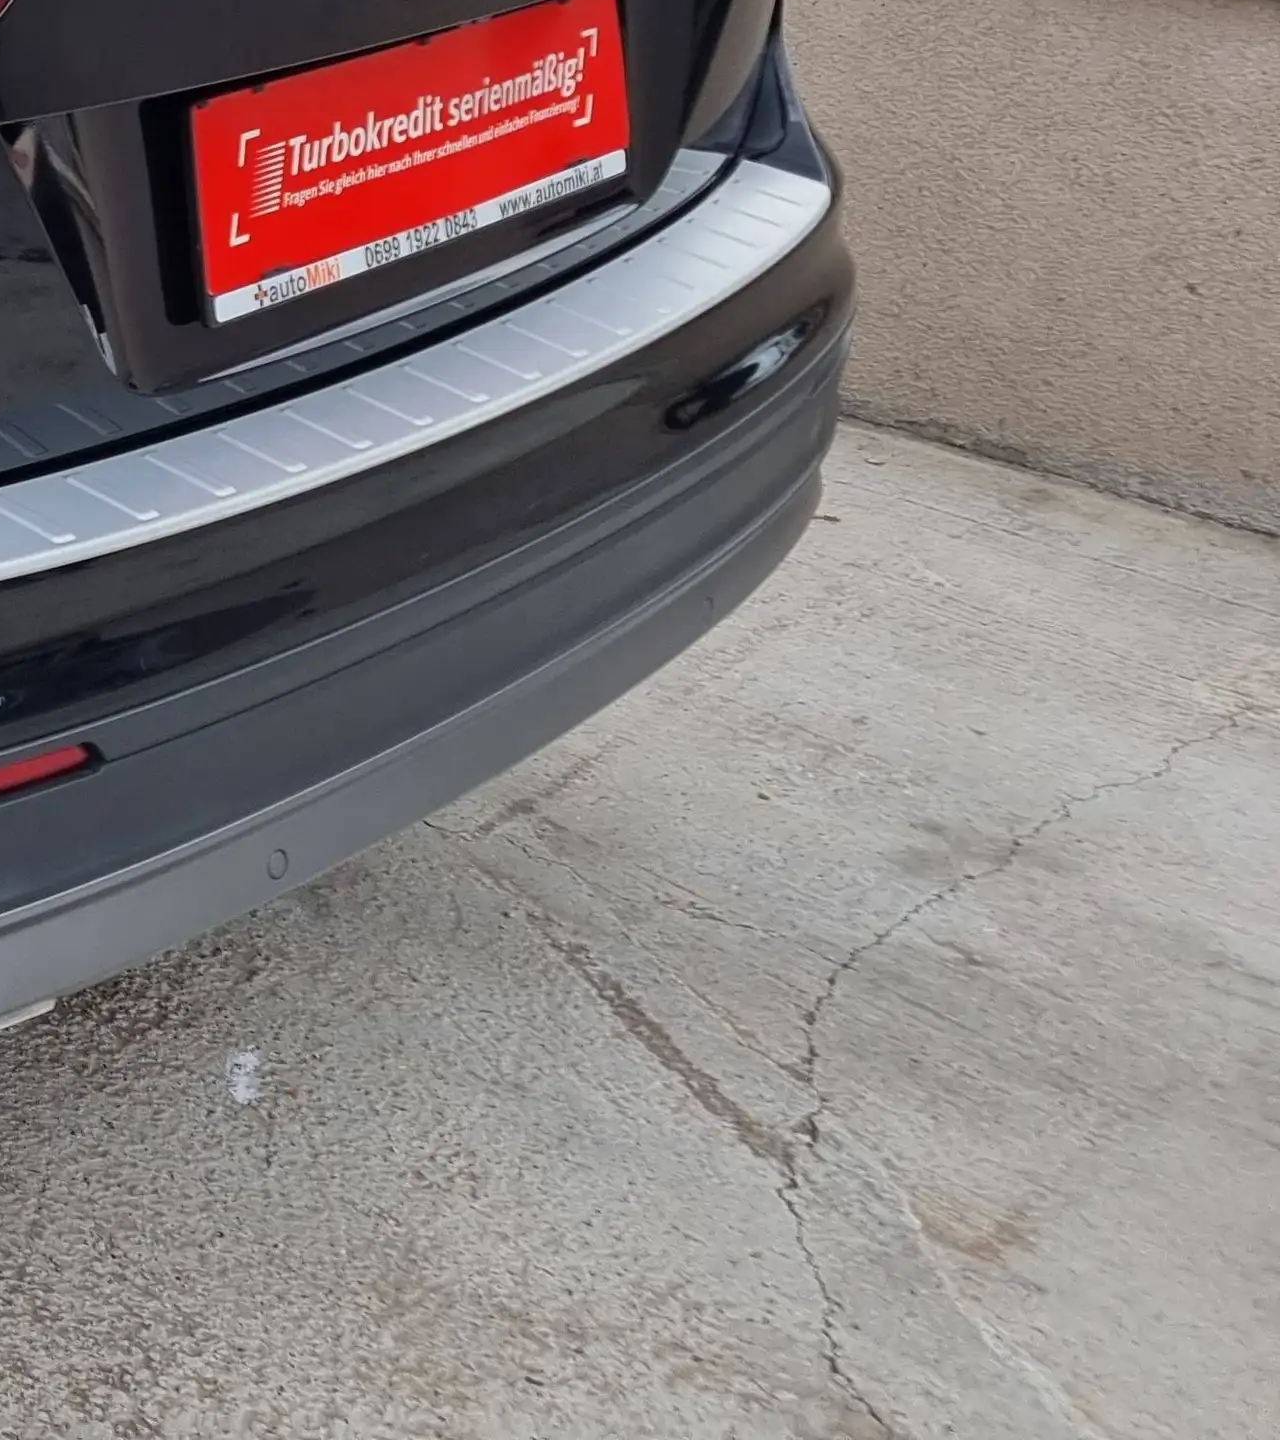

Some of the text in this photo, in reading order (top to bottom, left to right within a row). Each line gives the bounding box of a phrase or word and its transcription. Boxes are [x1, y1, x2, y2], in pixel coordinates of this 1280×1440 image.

[282, 95, 581, 208] Fragen Sie gleich hier nach Ihrer schnellen und einfachen Finanzierung!
[289, 47, 586, 176] Turbokredit serienmäßig!
[268, 161, 605, 303] autoMiki 0699 1922 0843 www.automiki.at
